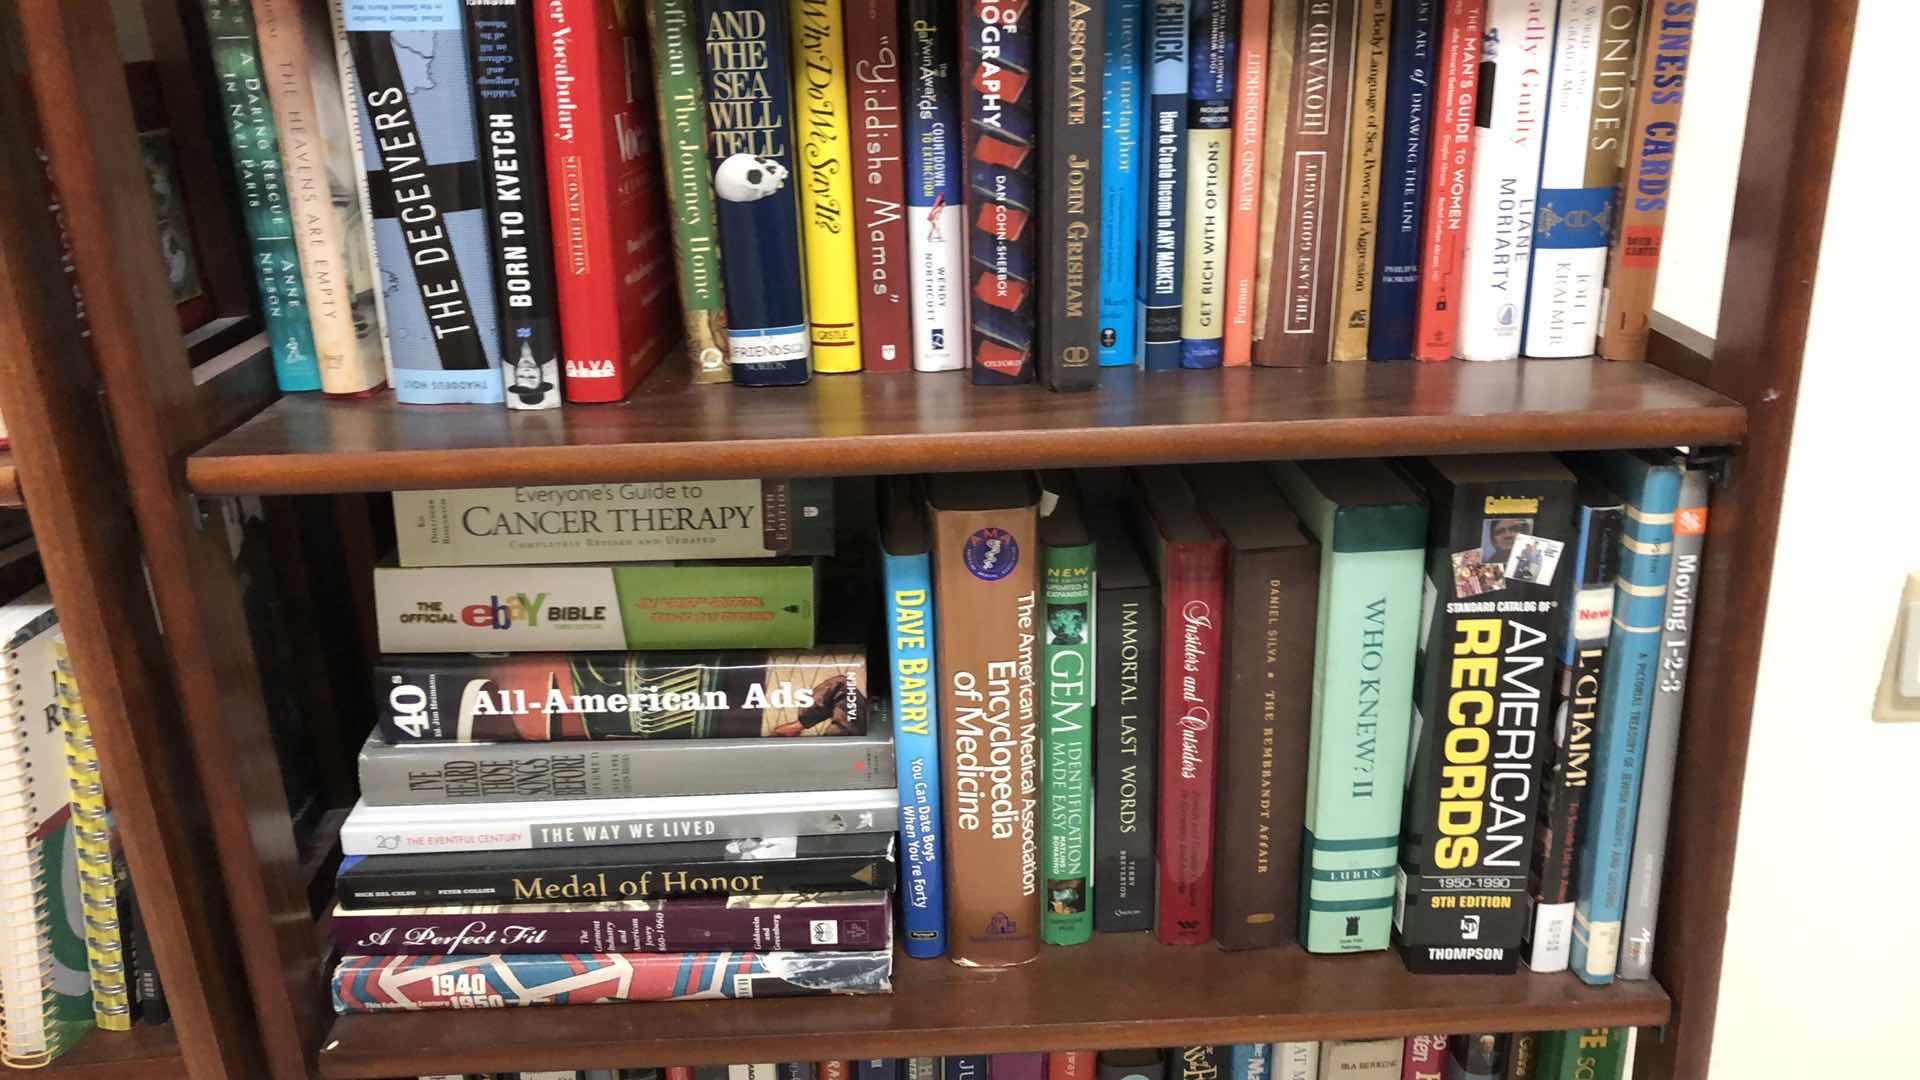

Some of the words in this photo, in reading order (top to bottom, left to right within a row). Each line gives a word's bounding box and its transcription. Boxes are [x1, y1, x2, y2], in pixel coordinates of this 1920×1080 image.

[706, 10, 767, 41] AND
[800, 0, 830, 54] Why
[1001, 9, 1018, 34] OF
[1466, 8, 1479, 32] THE
[240, 52, 254, 66] A
[706, 40, 769, 70] THE
[913, 19, 937, 67] darwin
[1066, 0, 1092, 126] ASSOCIATE
[1120, 16, 1135, 76] never
[1415, 30, 1427, 56] ART
[1460, 37, 1478, 89] MAN'S
[278, 62, 295, 97] THE
[551, 27, 577, 143] Vocabulary
[713, 70, 771, 100] SEA
[806, 54, 832, 99] Do
[918, 66, 939, 120] Awards
[1303, 23, 1329, 127] HOWARD
[1409, 68, 1428, 87] of
[244, 77, 267, 151] DARING
[672, 88, 696, 127] The
[709, 100, 782, 130] WILL
[807, 101, 837, 143] We
[1118, 79, 1138, 174] metaphor
[1407, 93, 1423, 163] DRAWING
[1455, 93, 1473, 143] GUIDE
[1510, 68, 1540, 147] Guilty
[223, 73, 239, 93] IN
[242, 159, 261, 208] PARIS
[288, 110, 320, 203] HEAVENS
[489, 113, 522, 201] KVETCH
[712, 128, 784, 158] TELL
[921, 131, 933, 144] TO
[930, 122, 945, 187] COUNTDOWN
[1455, 149, 1467, 165] TO
[368, 86, 450, 267] DECEIVERS
[677, 139, 700, 227] Journey
[806, 143, 841, 199] Say
[922, 146, 935, 198] EXTINCTION
[995, 175, 1007, 202] DAN
[1066, 154, 1091, 214] JOHN
[1205, 140, 1221, 210] OPTIONS
[1404, 168, 1417, 195] THE
[1635, 121, 1677, 214] CARDS
[260, 158, 284, 226] RESCUE
[1299, 162, 1318, 252] GOODNIGHT
[1448, 168, 1466, 230] WOMEN
[306, 212, 326, 248] ARE
[499, 210, 526, 238] TO
[814, 199, 840, 235] It?
[1203, 215, 1217, 255] WITH
[1401, 201, 1414, 232] LINE
[1491, 178, 1518, 292] MORIARTY
[1514, 199, 1533, 262] LIANE
[259, 252, 280, 318] NELSON
[280, 258, 301, 308] ANNE
[314, 258, 338, 321] EMPTY
[503, 246, 533, 308] BORN
[690, 237, 711, 299] Home
[923, 252, 936, 322] NORTHCUTT
[936, 266, 947, 308] WENDY
[1066, 220, 1090, 318] GRISHAM
[1201, 259, 1214, 295] RICH
[1297, 257, 1313, 291] LAST
[424, 278, 472, 340] THE
[1200, 301, 1213, 328] GET
[1296, 296, 1309, 323] THE
[514, 484, 616, 506] Everyone's
[618, 484, 674, 502] Guide
[680, 484, 704, 500] to
[461, 506, 602, 538] CANCER
[606, 505, 755, 533] THERAPY
[1047, 567, 1089, 578] NEW
[1664, 553, 1698, 632] Moving
[400, 612, 457, 626] OFFICIAL
[416, 600, 443, 613] THE
[547, 605, 607, 622] BIBLE
[894, 589, 927, 652] DAVE
[1016, 590, 1036, 628] The
[1268, 578, 1281, 626] DANIEL
[1446, 602, 1496, 614] STANDARD
[1496, 601, 1536, 613] CATALOG
[1579, 608, 1611, 620] New
[1120, 601, 1138, 706] IMMORTAL
[1182, 599, 1213, 671] Insiders
[1265, 628, 1279, 664] SILVA
[1361, 597, 1388, 672] WHO
[953, 671, 984, 702] of
[1017, 632, 1036, 721] American
[1660, 639, 1689, 694] 1-2-3
[471, 685, 730, 719] All-American
[742, 680, 816, 710] Ads
[845, 671, 858, 723] TASCHEN
[898, 656, 930, 738] BARRY
[1050, 649, 1085, 736] GEM
[1182, 674, 1199, 703] and
[1264, 689, 1277, 722] THE
[1120, 713, 1137, 757] LAST
[1353, 677, 1382, 774] KNEW?
[1565, 649, 1603, 788] L'CHAIM!
[986, 659, 1021, 840] Encyclopedia
[1019, 723, 1037, 796] Medical
[1180, 705, 1213, 781] Outsiders
[1433, 618, 1504, 868] RECORDS
[1483, 619, 1549, 867] AMERICAN
[409, 767, 442, 794] I'VE
[443, 759, 477, 798] HEARD
[479, 759, 514, 800] THOSE
[516, 755, 551, 799] SONGS
[551, 753, 587, 797] BEFORE
[911, 758, 925, 780] You
[954, 705, 986, 831] Medicine
[1052, 741, 1067, 789] MADE
[1259, 727, 1275, 819] REMBRANDT
[915, 783, 928, 804] Can
[1067, 741, 1082, 875] IDENTIFICATION
[1119, 762, 1137, 835] WORDS
[1352, 780, 1374, 799] II
[541, 827, 577, 843] THE
[583, 824, 622, 842] WAY
[629, 822, 657, 840] WE
[662, 820, 717, 838] LIVED
[903, 806, 918, 839] When
[917, 806, 932, 833] Date
[1052, 795, 1067, 831] EASY
[406, 836, 426, 847] THE
[427, 834, 477, 847] EVENTFUL
[477, 832, 524, 846] CENTURY
[908, 841, 924, 876] You're
[920, 835, 937, 862] Boys
[1021, 798, 1037, 897] Association
[1257, 823, 1271, 874] AFFAIR
[511, 876, 611, 902] Medal
[617, 871, 652, 899] of
[663, 868, 764, 894] Honor
[911, 878, 928, 909] Forty
[1127, 861, 1136, 888] TERRY
[1329, 869, 1383, 882] LUBIN
[1437, 876, 1512, 890] 1950-1990
[1431, 896, 1456, 909] 9TH
[1459, 895, 1512, 909] EDITION
[356, 927, 398, 948] A
[402, 920, 498, 955] Perfect
[499, 924, 549, 946] Fit
[579, 929, 590, 945] The
[592, 919, 602, 952] Garment
[605, 920, 617, 951] Industry
[1428, 948, 1504, 961] THOMPSON
[430, 973, 487, 997] 1940
